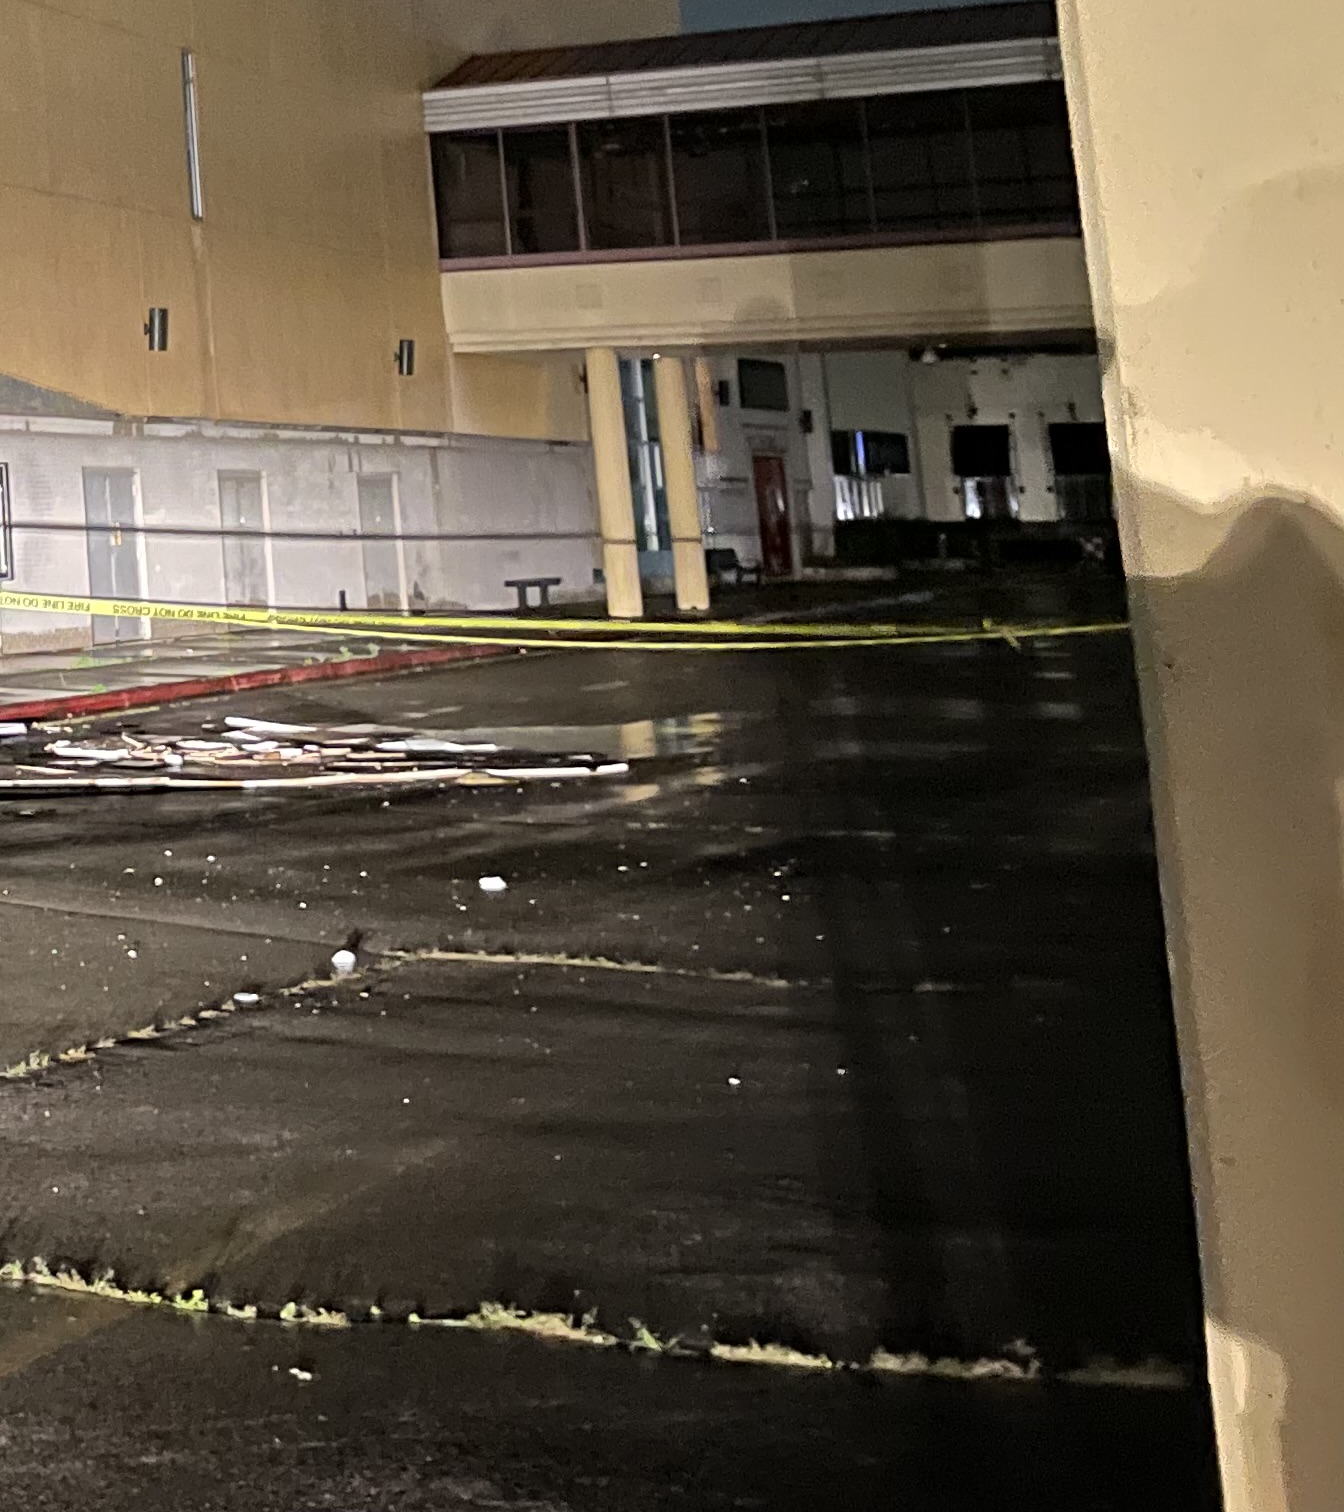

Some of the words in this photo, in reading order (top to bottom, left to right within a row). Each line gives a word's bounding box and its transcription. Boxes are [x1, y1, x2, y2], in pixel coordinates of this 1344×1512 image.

[22, 597, 39, 608] DO
[42, 599, 65, 610] LINE
[67, 601, 91, 612] FIRE
[112, 603, 151, 616] CROSS
[153, 606, 176, 618] NOT
[178, 608, 194, 619] DO
